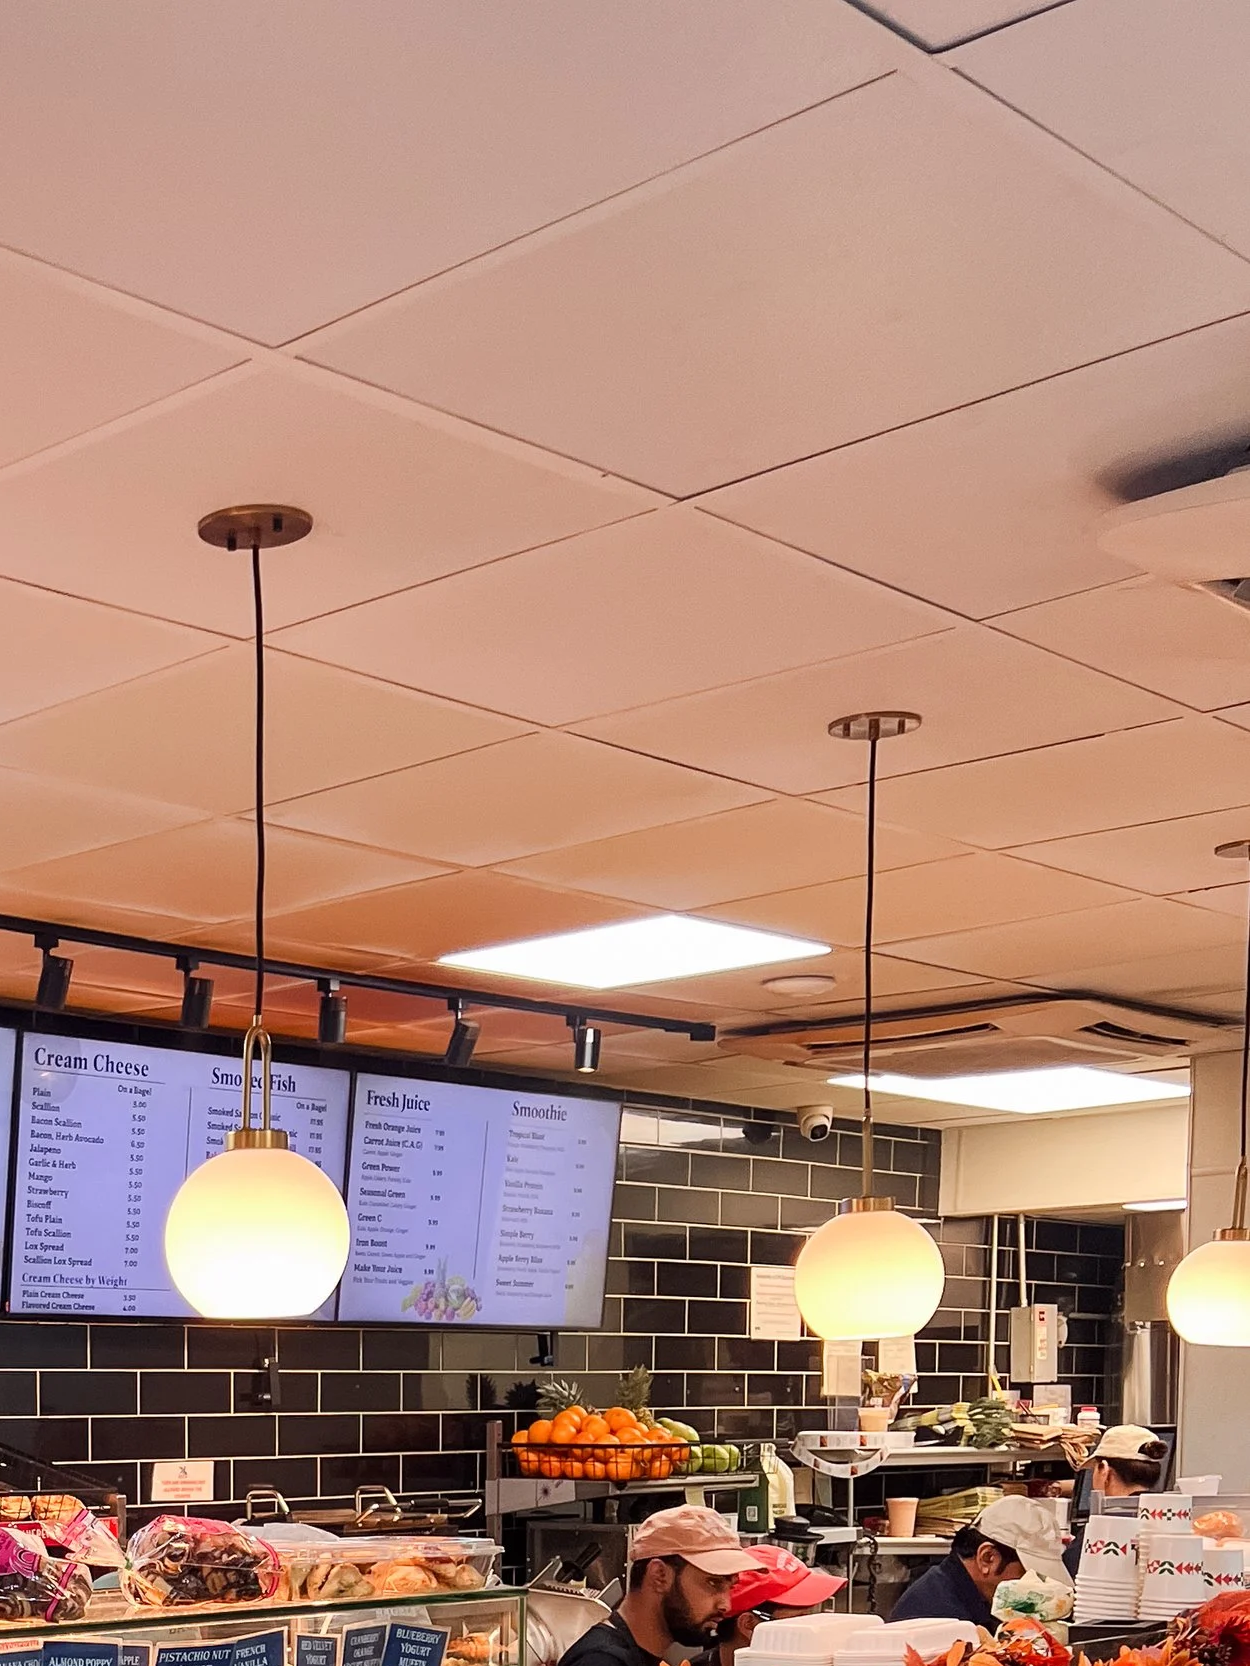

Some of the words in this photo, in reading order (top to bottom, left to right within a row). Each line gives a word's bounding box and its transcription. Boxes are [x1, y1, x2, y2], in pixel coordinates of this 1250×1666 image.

[34, 1047, 88, 1070] Cream
[93, 1054, 149, 1077] Cheese
[366, 1089, 399, 1109] Fresh
[400, 1094, 431, 1113] Juice
[512, 1100, 568, 1122] Smoothie
[27, 1186, 69, 1199] Strawberry
[396, 1628, 442, 1644] BLUEBERRY
[158, 1650, 210, 1663] PISTACHIO
[211, 1649, 232, 1660] NUT
[235, 1644, 266, 1659] FRENCH
[400, 1643, 432, 1657] YOGURT
